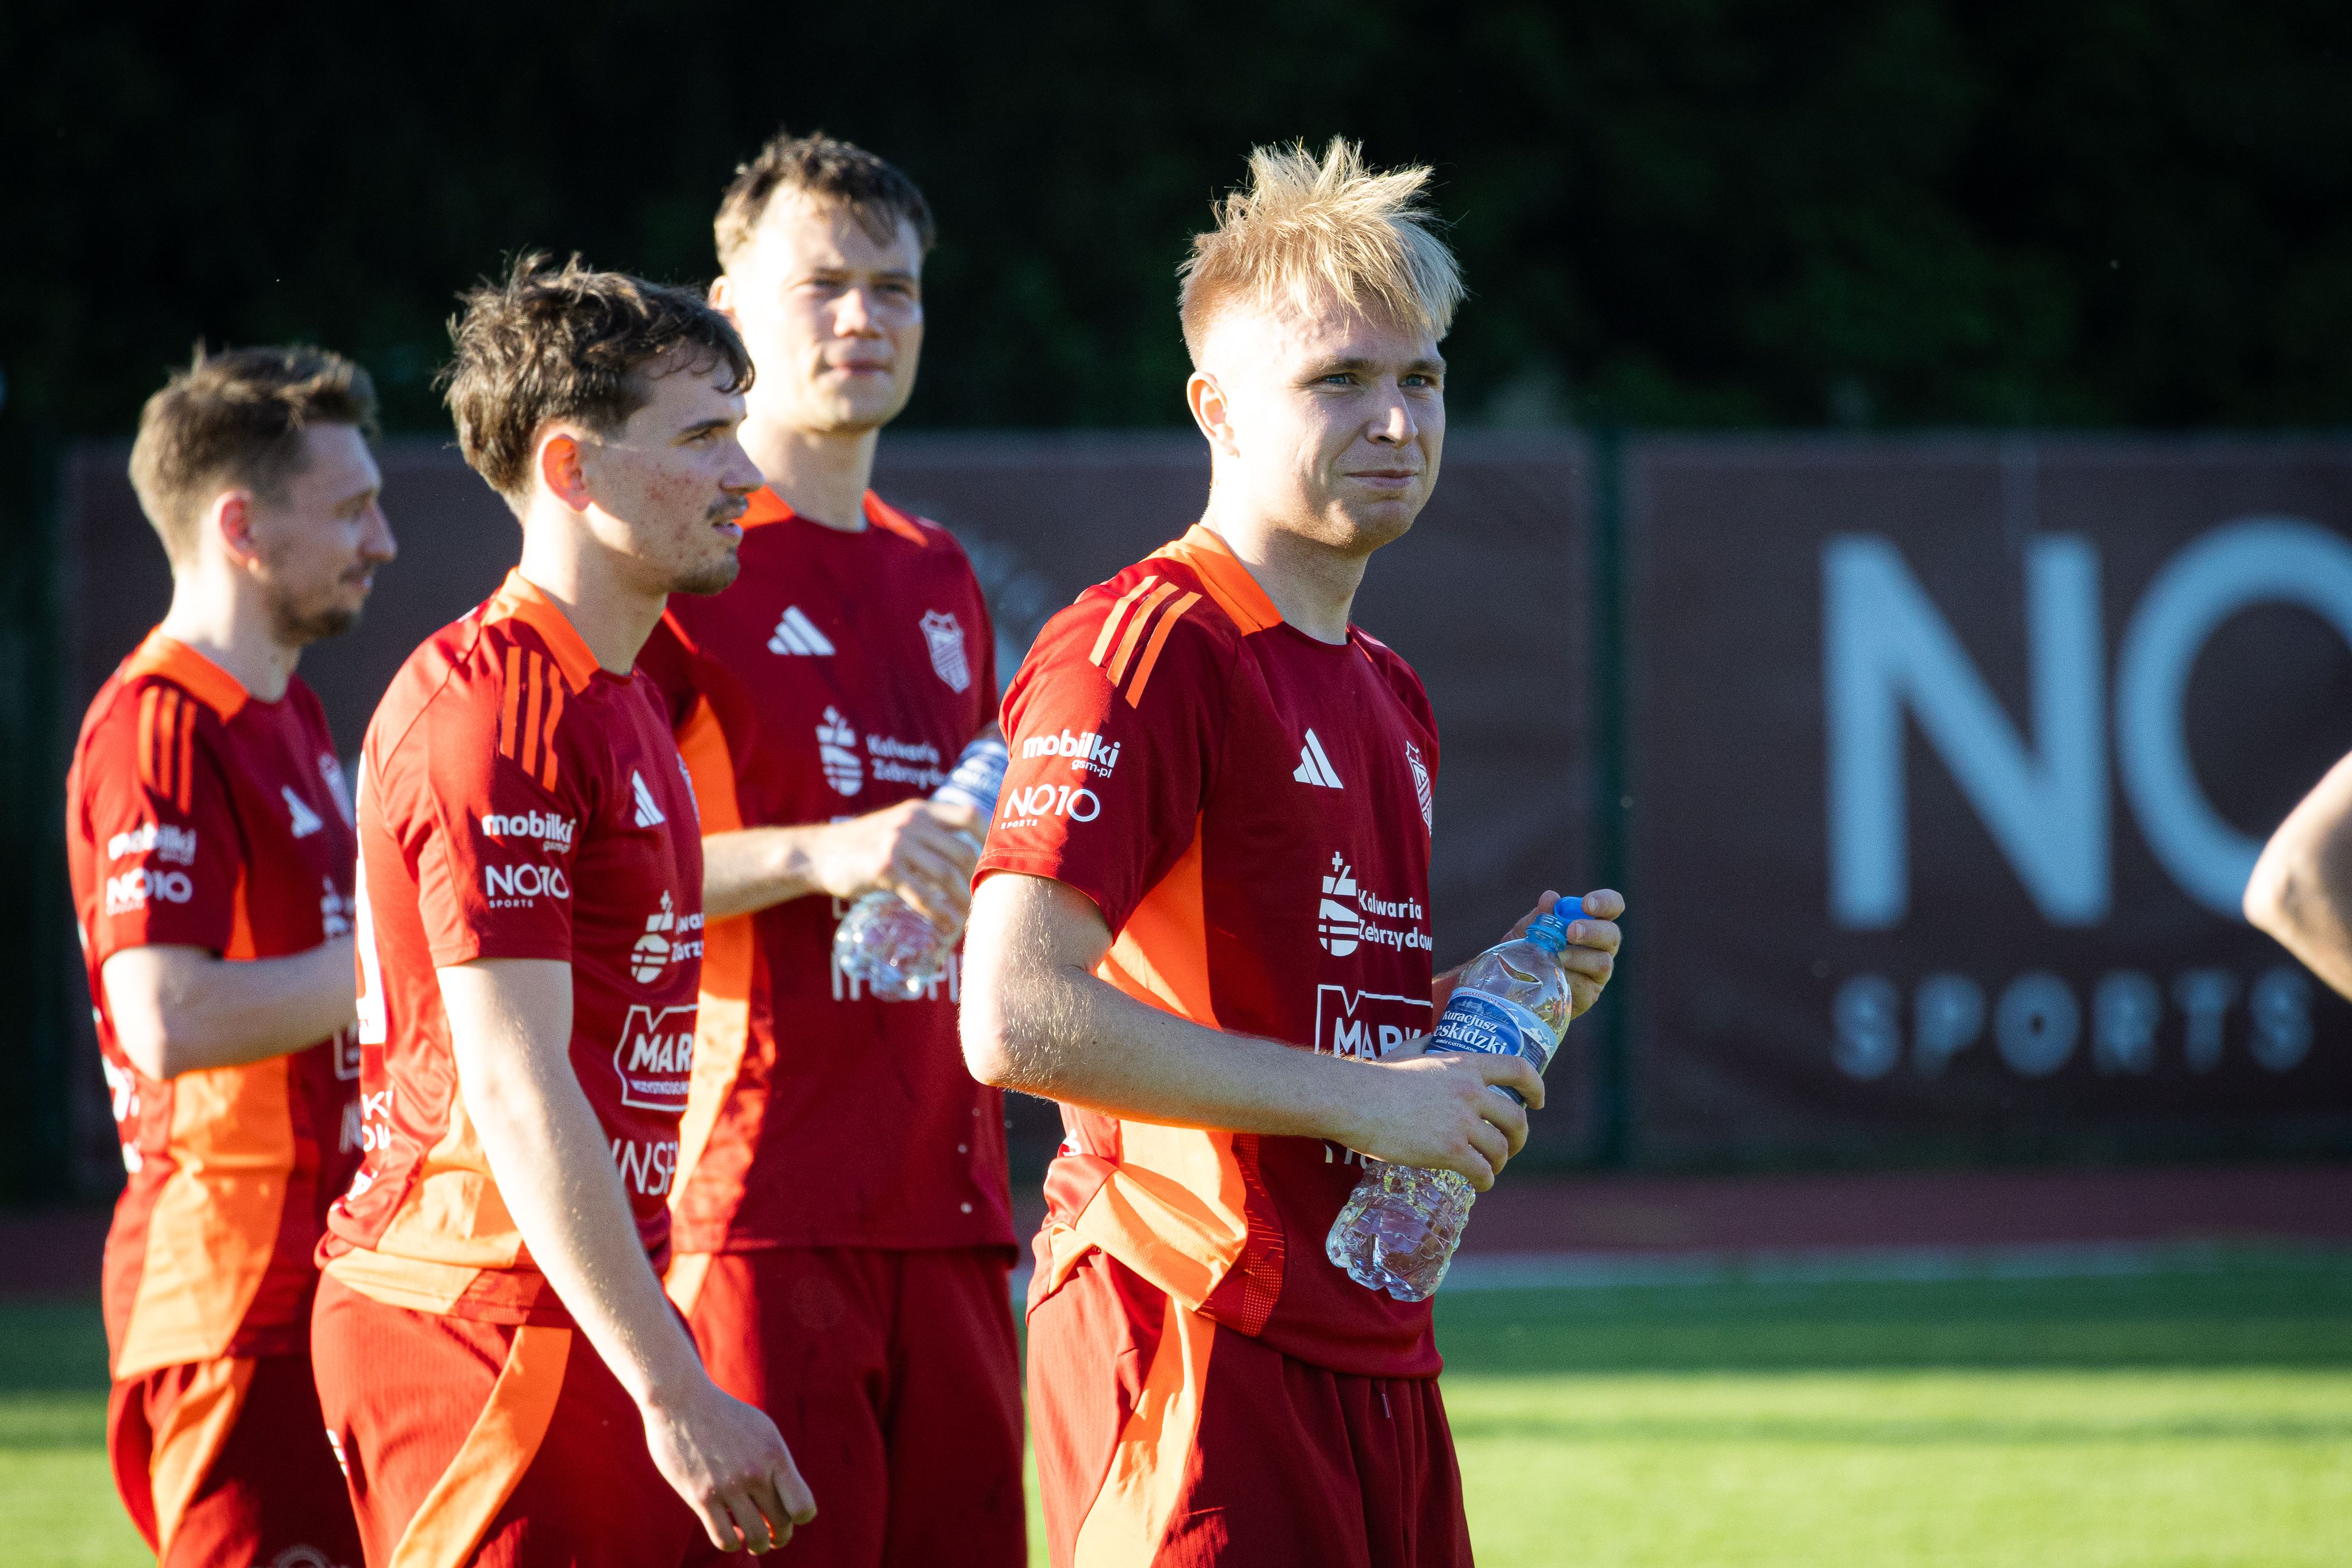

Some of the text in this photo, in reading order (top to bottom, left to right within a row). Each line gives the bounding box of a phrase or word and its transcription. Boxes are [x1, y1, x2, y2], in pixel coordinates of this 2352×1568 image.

[1022, 729, 1120, 768] mobilki
[1071, 759, 1112, 778] gsm.pl
[482, 810, 577, 844] mobilki
[1000, 819, 1038, 829] SPORTS
[489, 899, 533, 908] SPORTS
[1358, 889, 1422, 920] Kalwaria
[1359, 919, 1433, 951] Zebrzydow
[1460, 991, 1498, 1004] NIEGAZOWANA
[1442, 1010, 1498, 1033] Kuracjusz
[1831, 970, 2315, 1082] SPORTS
